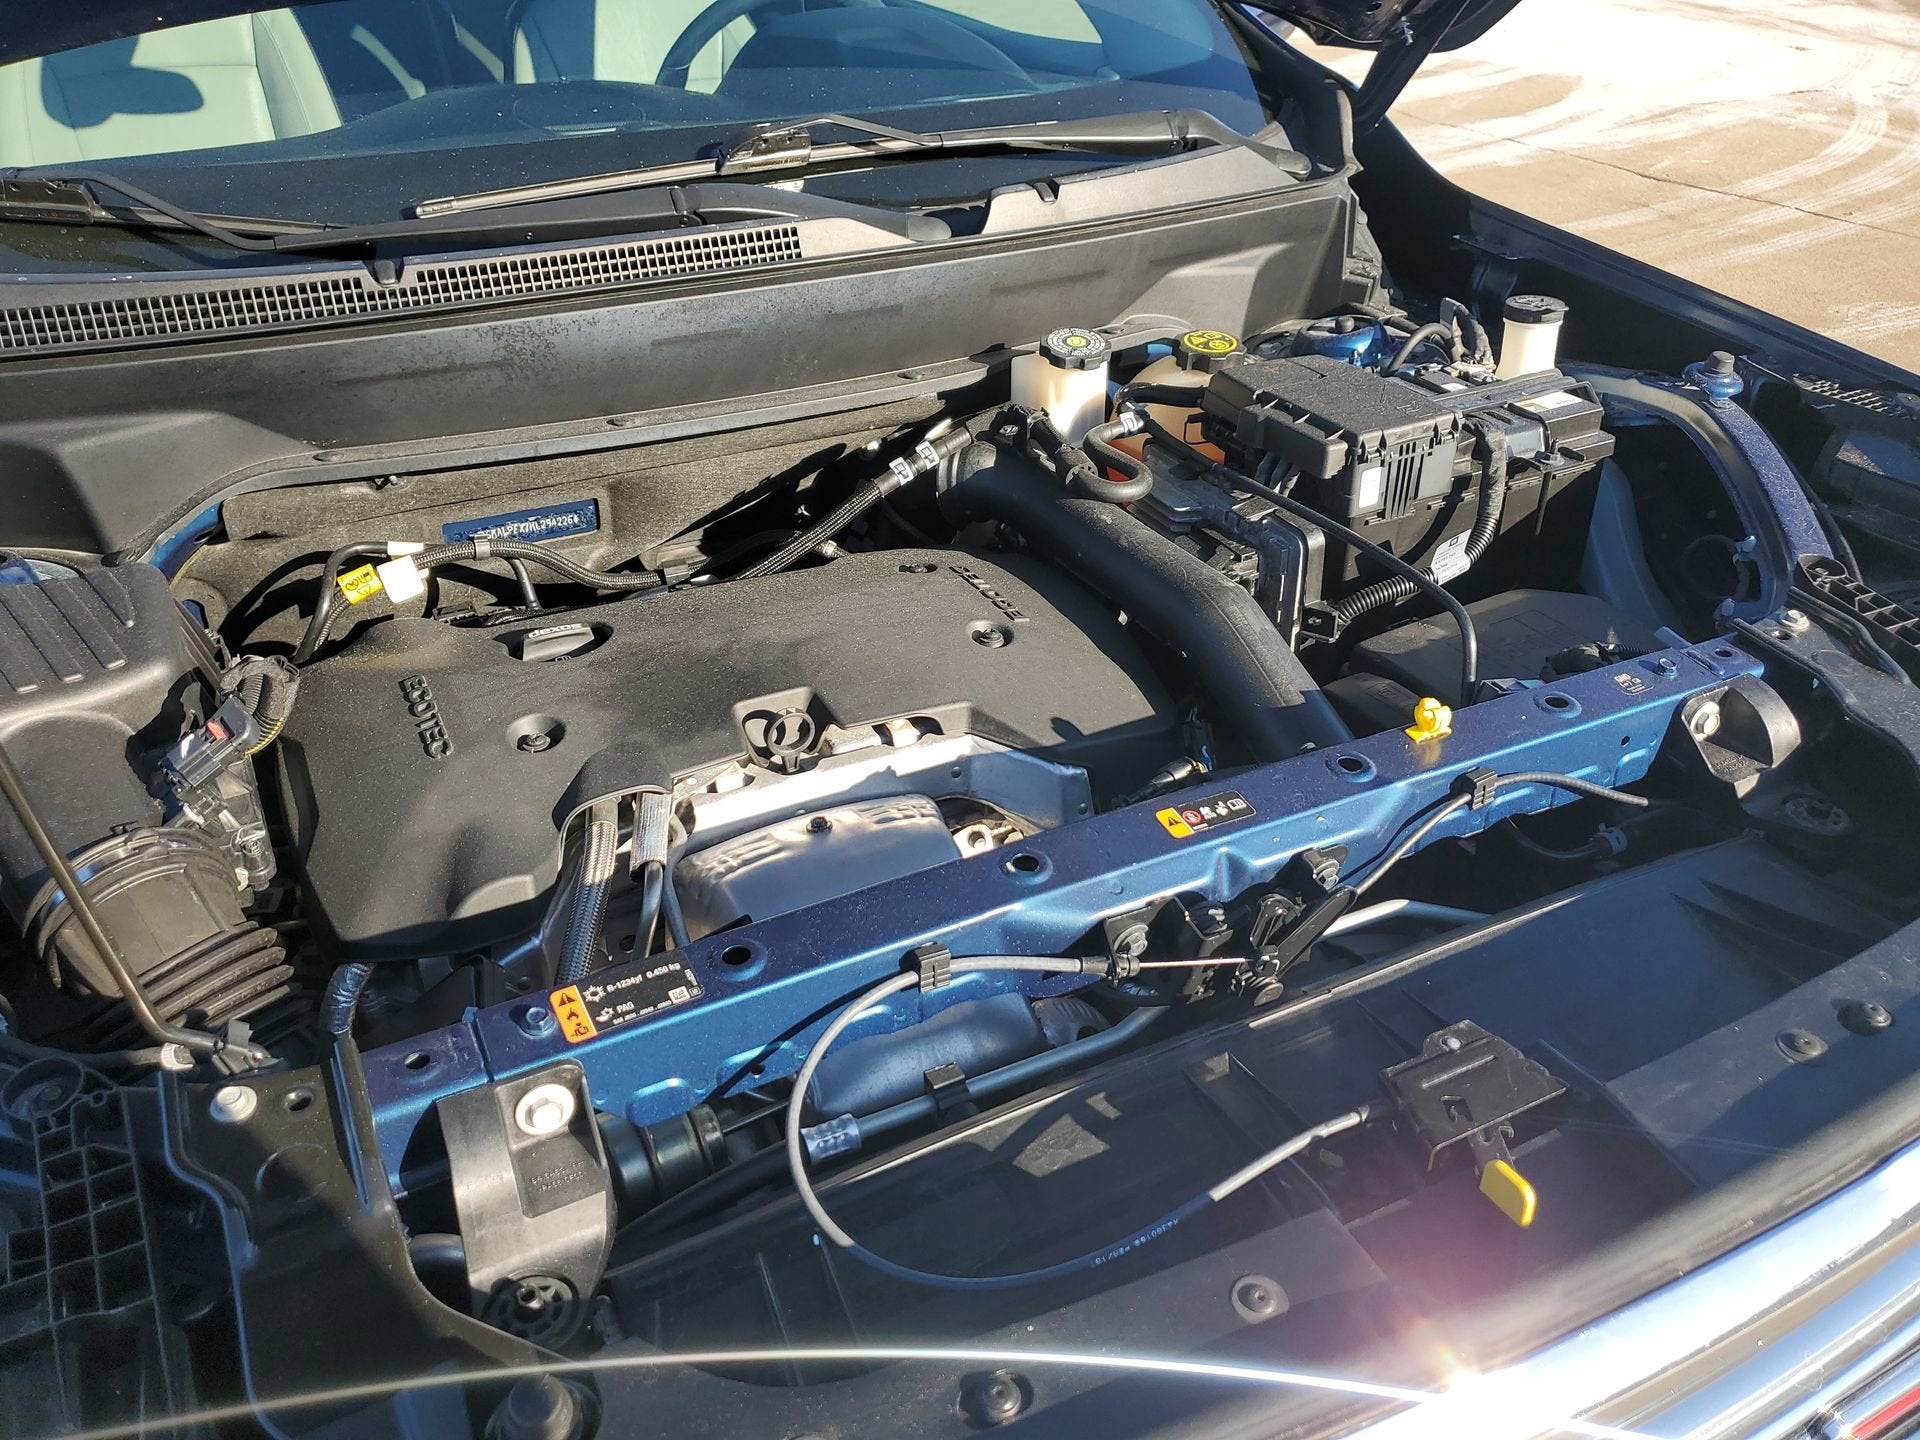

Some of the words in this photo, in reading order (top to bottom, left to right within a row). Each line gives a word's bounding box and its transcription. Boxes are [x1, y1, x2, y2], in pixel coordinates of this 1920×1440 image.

[947, 566, 1030, 622] ECOTEC
[528, 623, 582, 639] dexos
[398, 674, 454, 759] ECOTEC
[606, 974, 643, 992] R-1234yf
[646, 967, 668, 979] 0.450
[668, 962, 681, 972] kg
[616, 1001, 635, 1013] PAG
